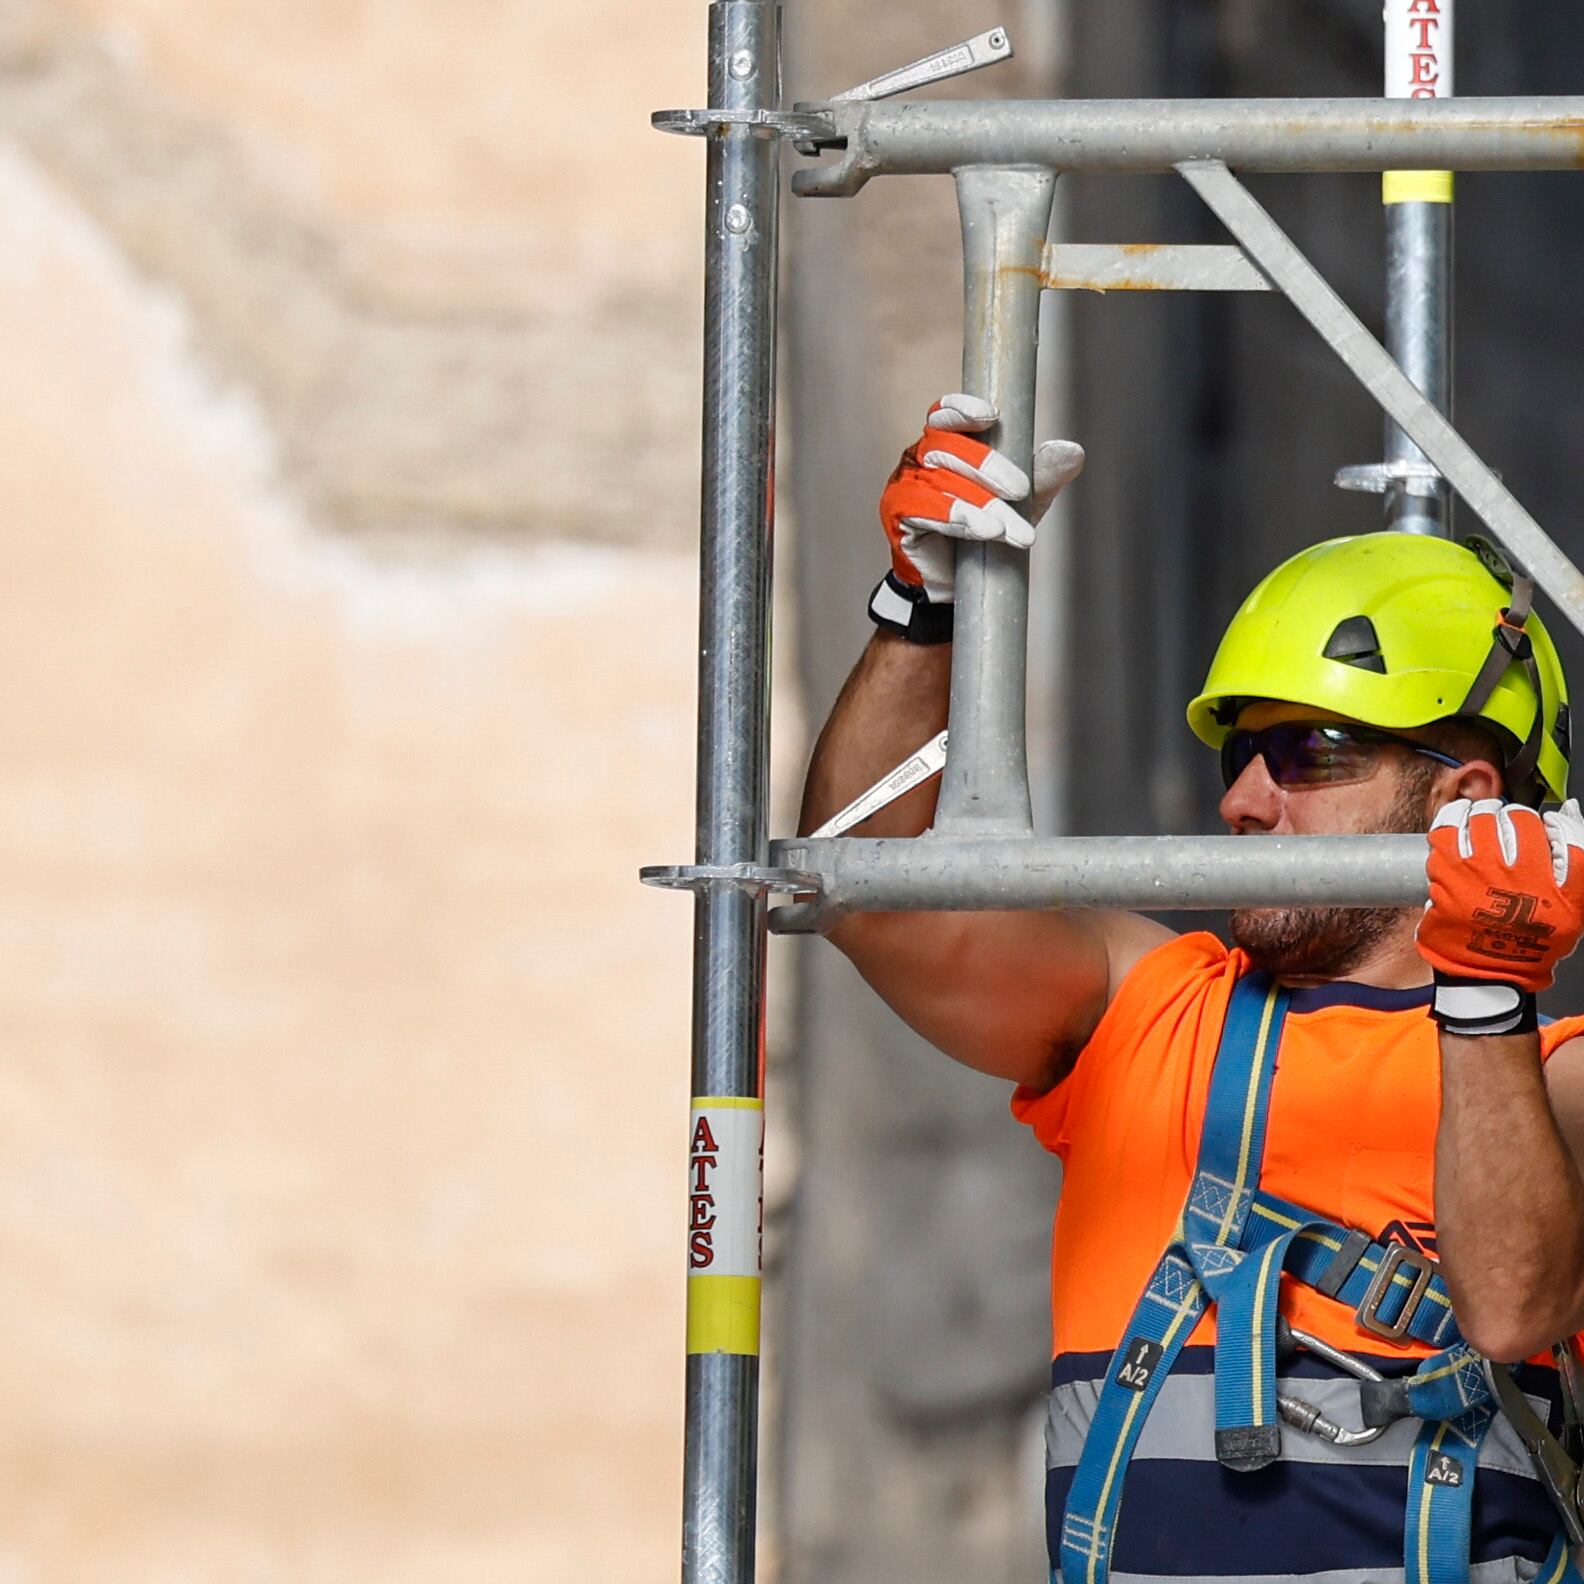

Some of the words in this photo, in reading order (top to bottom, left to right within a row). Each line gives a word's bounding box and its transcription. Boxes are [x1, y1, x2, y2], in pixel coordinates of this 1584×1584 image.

[690, 1116, 719, 1269] ATES
[1118, 1363, 1149, 1386] A/2
[1427, 1467, 1459, 1484] A/2
